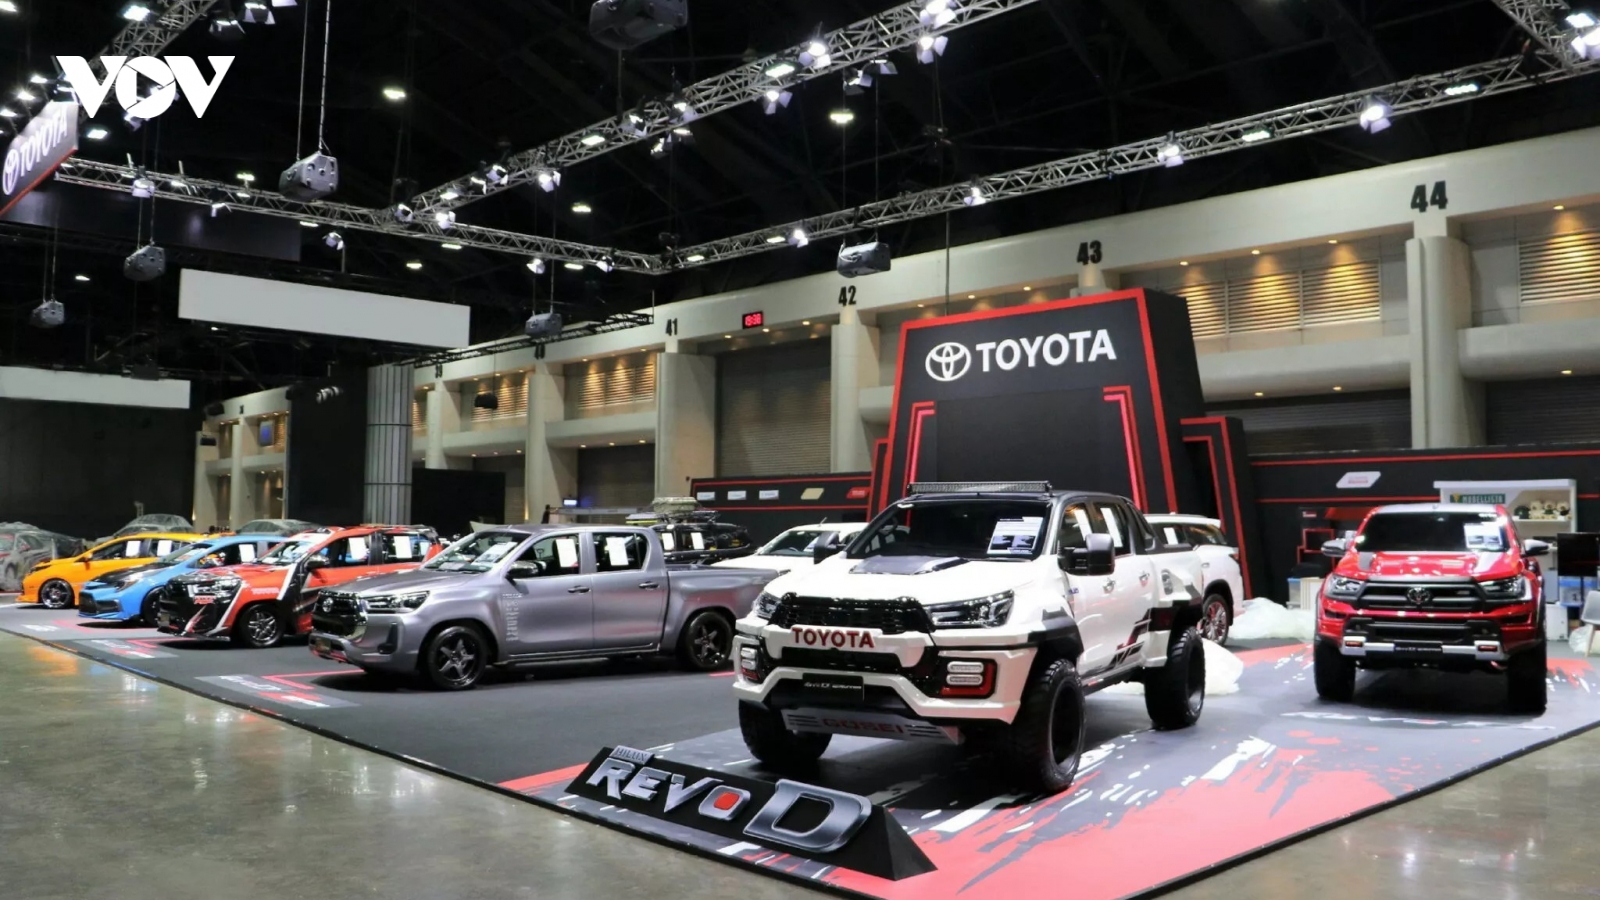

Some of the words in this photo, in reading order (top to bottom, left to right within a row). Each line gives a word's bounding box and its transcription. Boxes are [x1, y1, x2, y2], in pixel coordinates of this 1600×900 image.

[20, 104, 68, 177] TOYOTA
[1410, 180, 1449, 214] 44
[1076, 239, 1103, 266] 43
[838, 284, 857, 307] 42
[665, 318, 678, 337] 41
[975, 329, 1117, 373] TOYOTA
[792, 627, 875, 649] TOYOTA
[821, 717, 905, 734] GOSEI
[612, 746, 649, 762] HILUX
[586, 757, 751, 821] REVO
[743, 778, 872, 853] D
